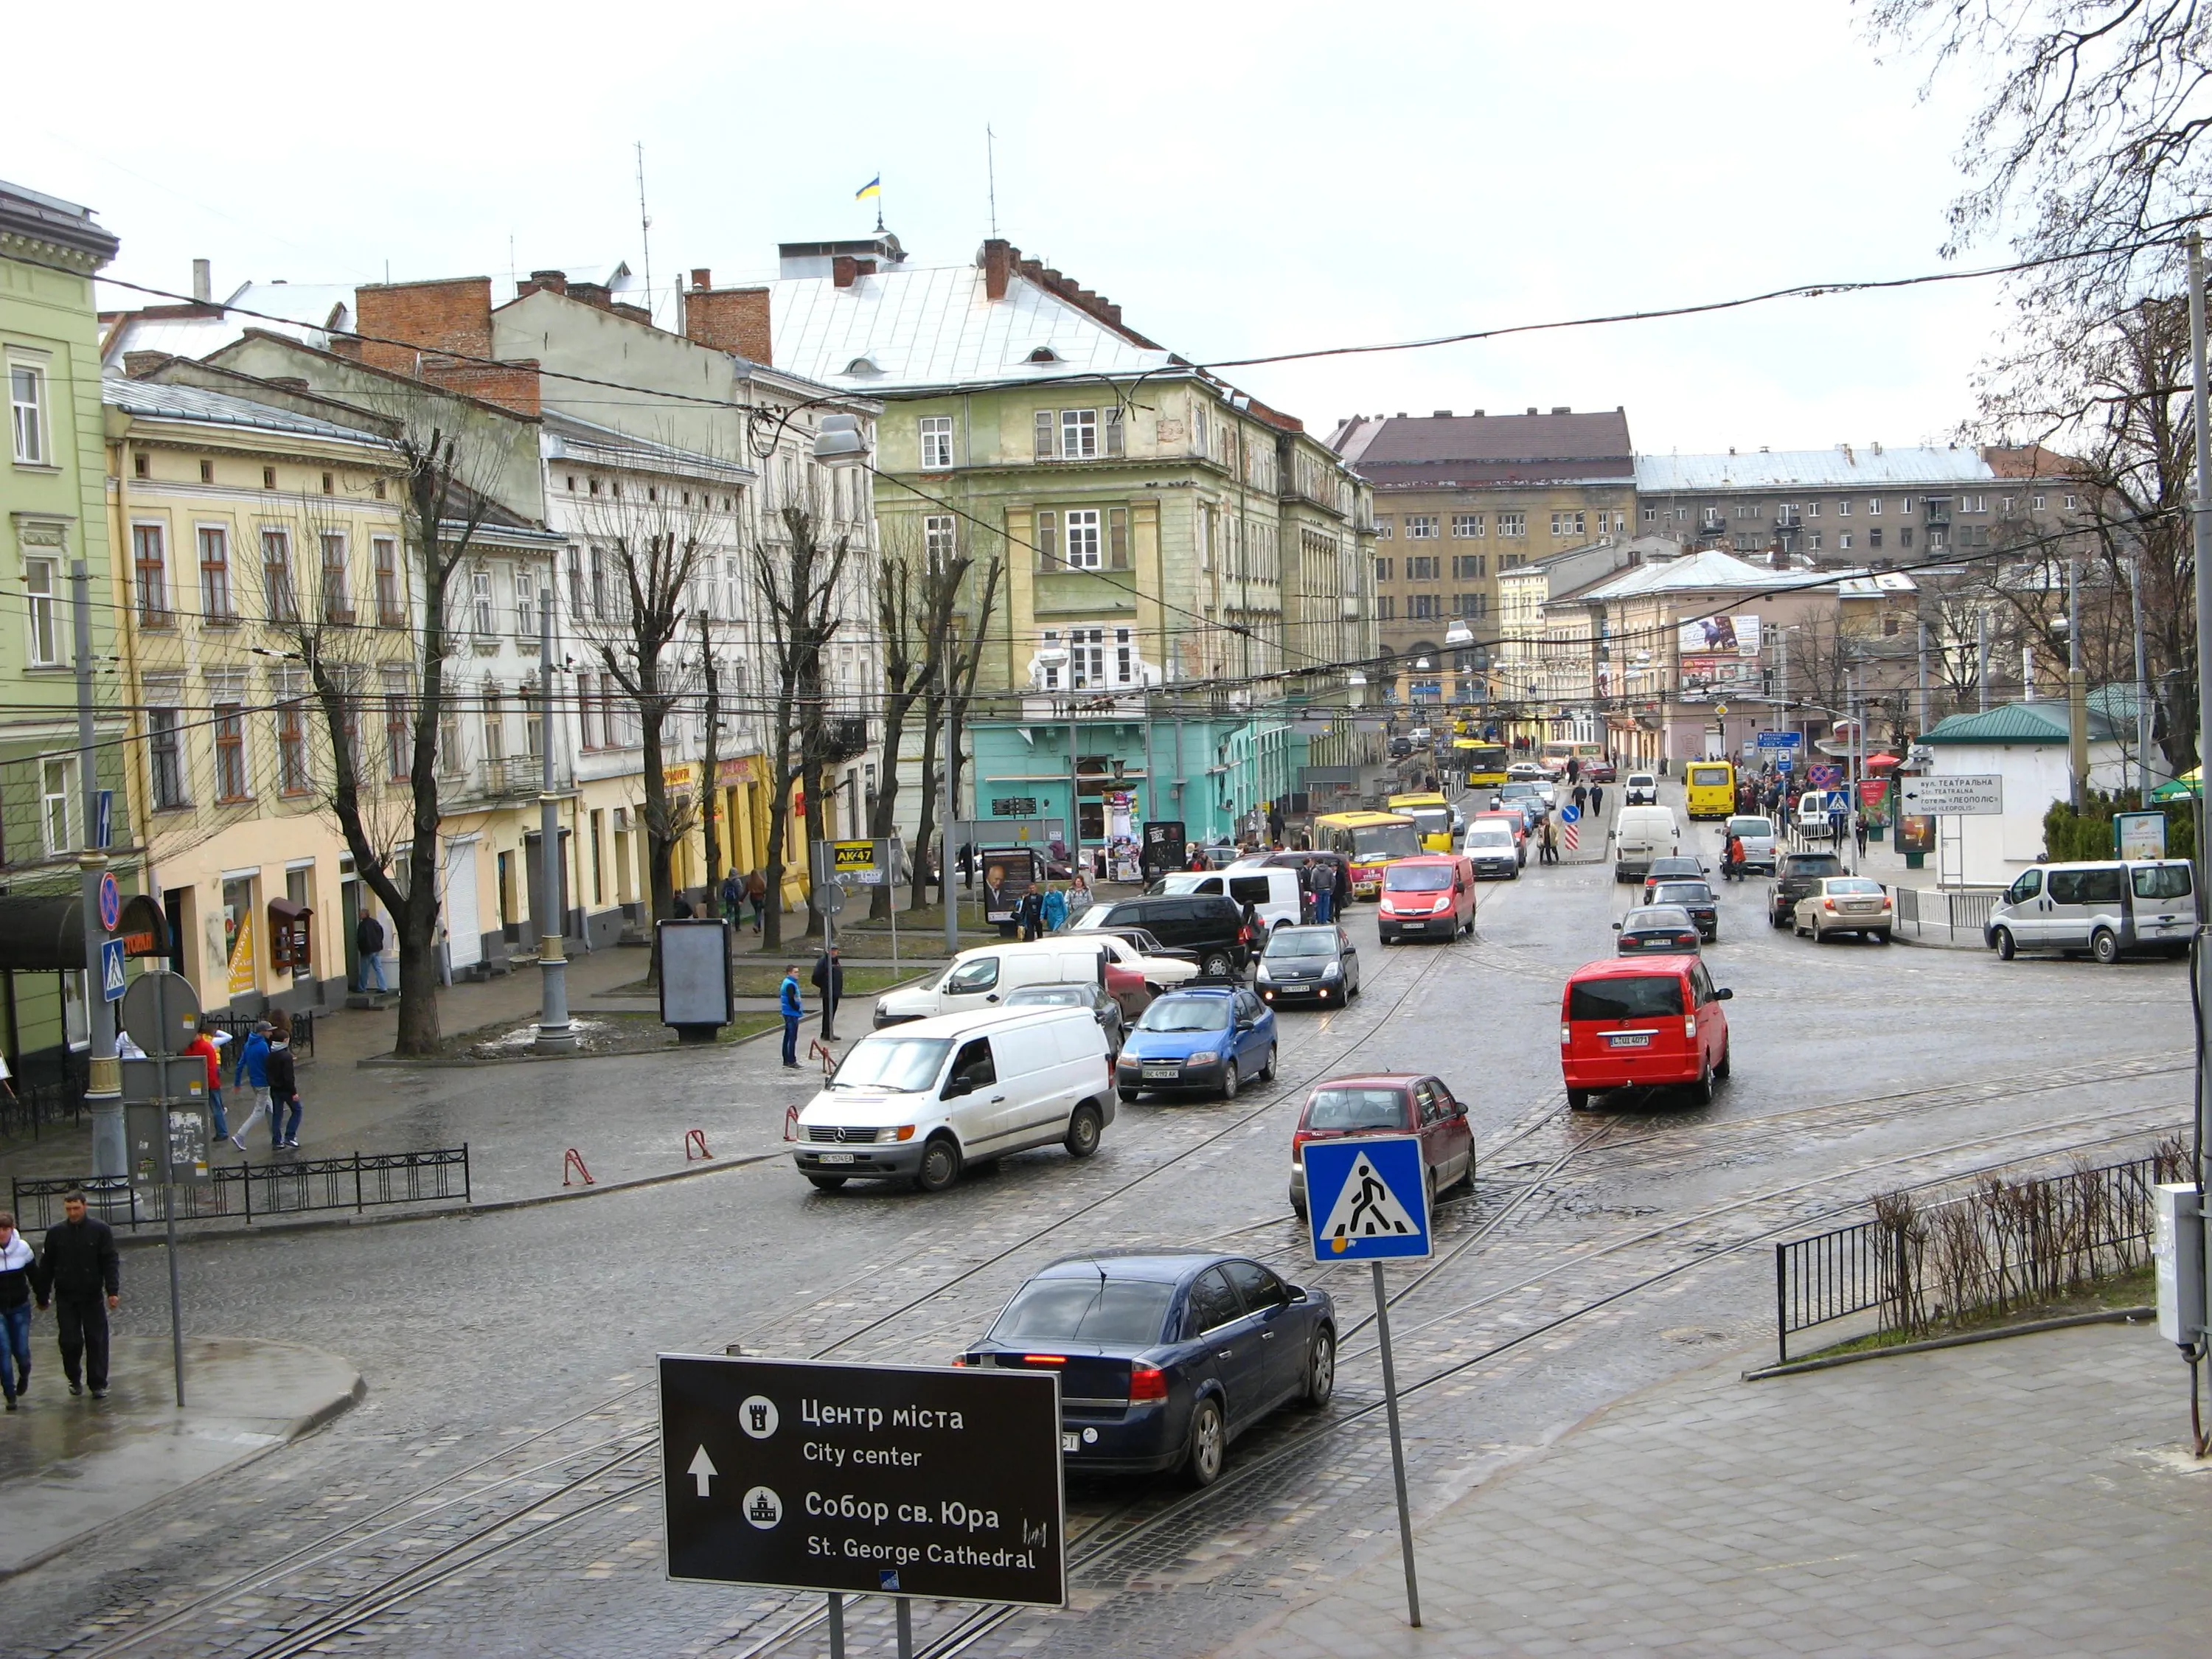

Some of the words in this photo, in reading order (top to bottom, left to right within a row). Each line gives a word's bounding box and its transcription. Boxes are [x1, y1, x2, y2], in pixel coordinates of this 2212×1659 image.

[1939, 779, 1993, 787] ТЕАТРАЛЬНА
[801, 1399, 883, 1432] Центр
[893, 1404, 964, 1430] міста
[803, 1441, 846, 1467] City
[852, 1446, 922, 1467] center
[805, 1491, 888, 1526] Собор
[897, 1504, 933, 1523] св.
[942, 1501, 999, 1533] Юра
[807, 1536, 836, 1557] St.
[844, 1538, 920, 1565] George
[927, 1544, 1036, 1569] Cathedral
